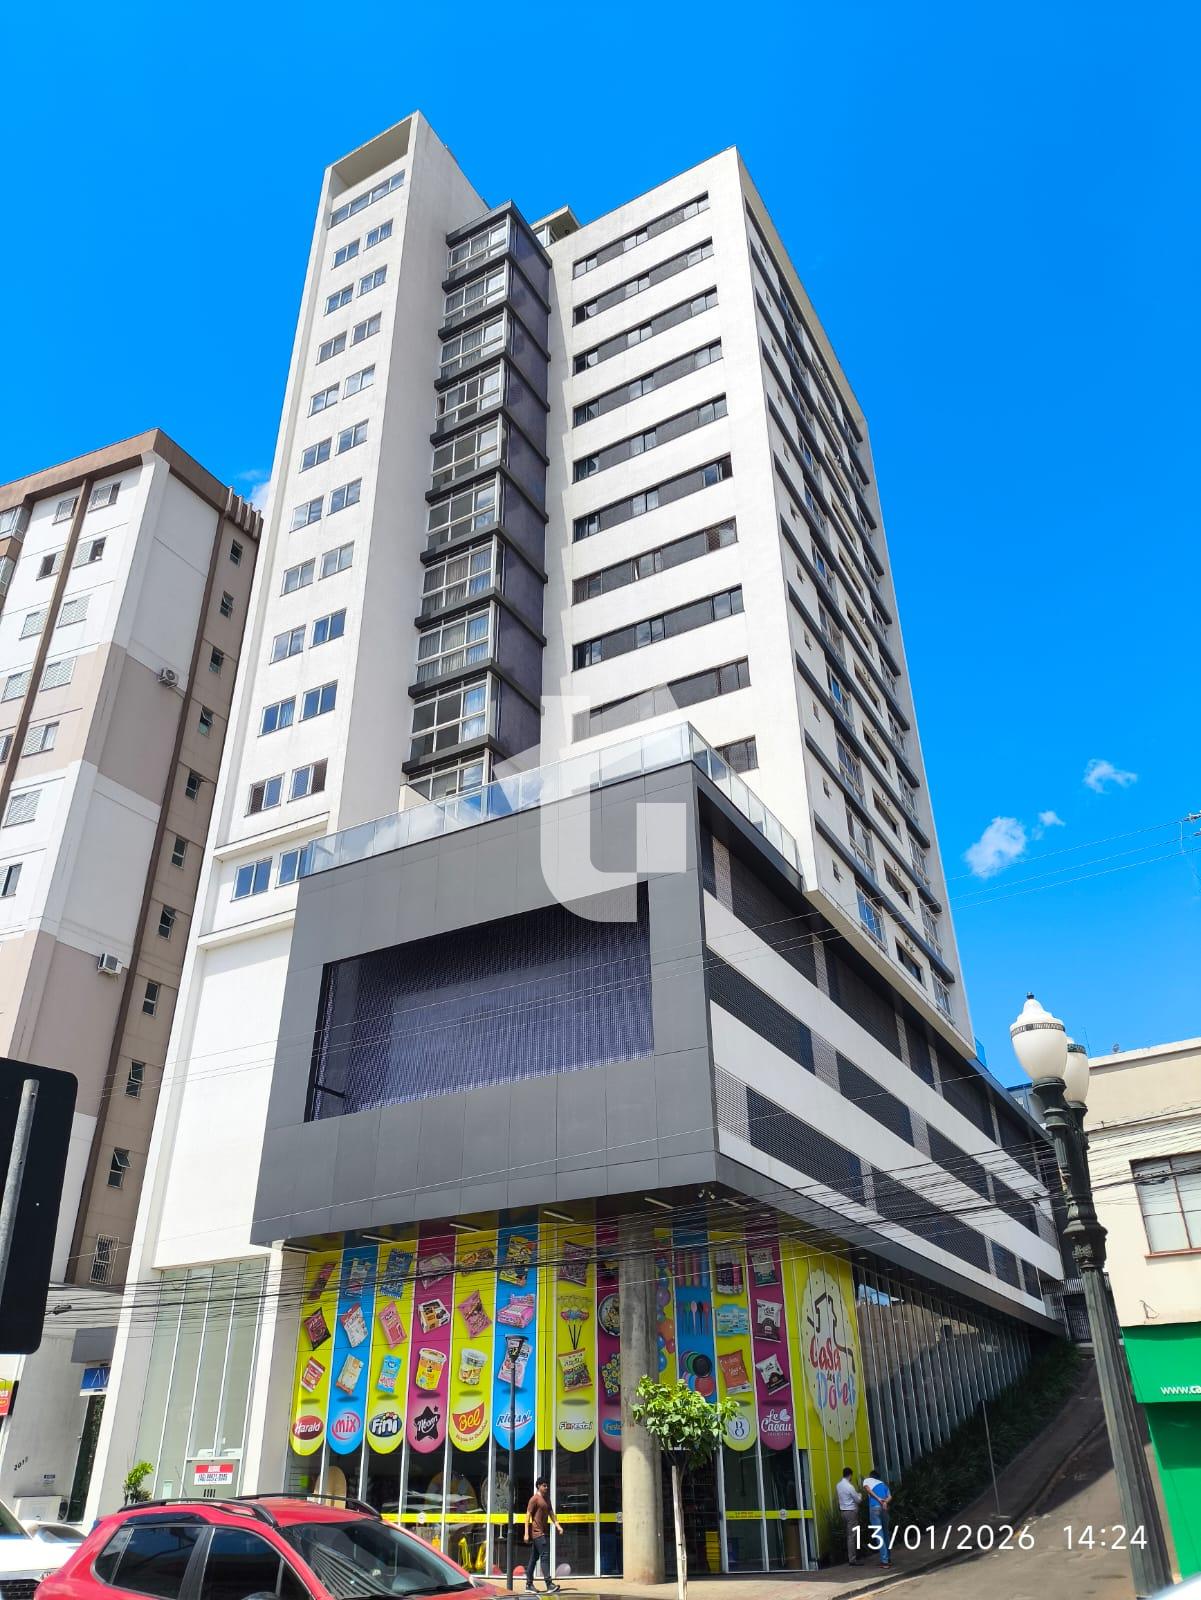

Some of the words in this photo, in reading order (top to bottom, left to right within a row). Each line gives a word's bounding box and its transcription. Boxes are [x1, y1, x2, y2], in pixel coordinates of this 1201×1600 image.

[294, 1421, 321, 1435] Harald
[336, 1416, 356, 1433] mix
[371, 1418, 398, 1434] Fini
[459, 1408, 480, 1432] Bel
[761, 1418, 792, 1432] Cacau
